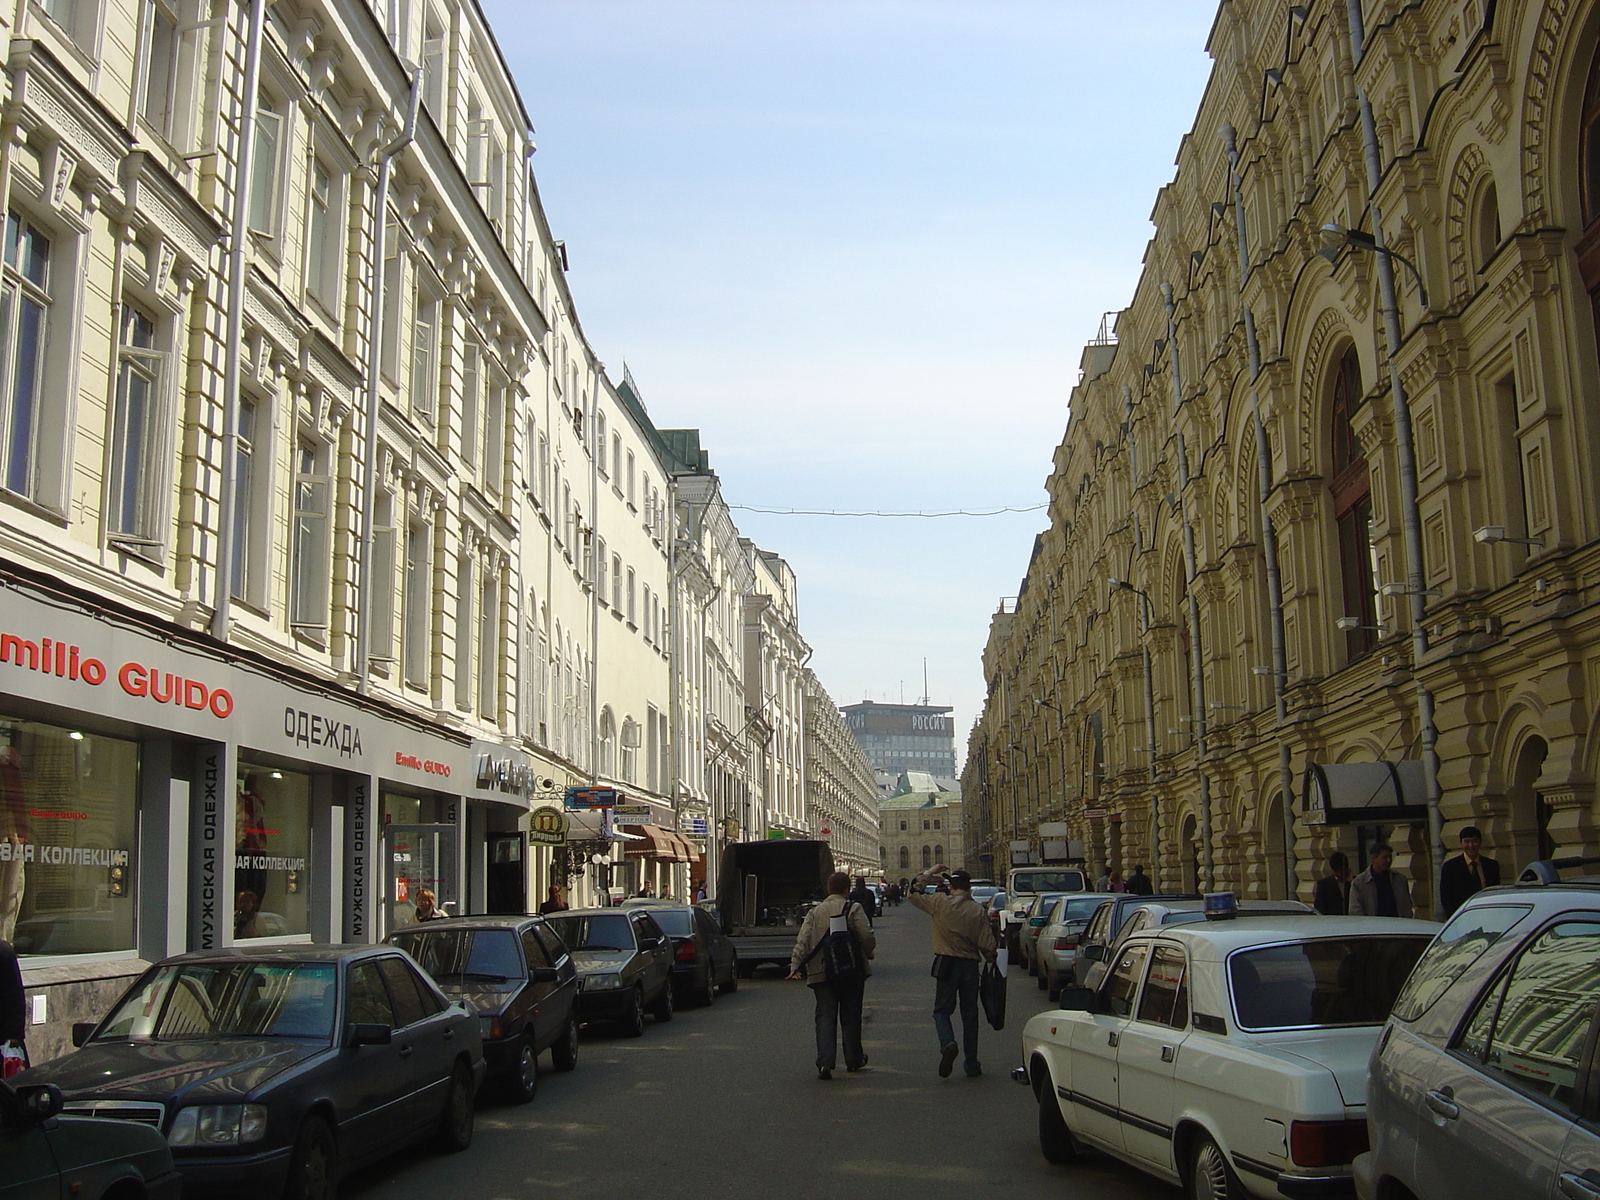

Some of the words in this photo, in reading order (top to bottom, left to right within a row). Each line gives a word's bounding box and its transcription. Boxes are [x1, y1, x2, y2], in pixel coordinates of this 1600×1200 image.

[118, 662, 234, 718] GUIDO
[285, 707, 362, 759] ОДЕЖДА
[847, 713, 865, 729] ССИЯ
[912, 714, 945, 730] РОССИЯ
[395, 752, 422, 771] Emilio
[423, 760, 451, 778] GUIDO
[60, 811, 87, 820] GUIDO
[204, 755, 217, 840] ОДЕЖДА
[354, 785, 365, 851] ОДЕЖДА
[0, 842, 34, 862] ВАЯ
[41, 845, 129, 867] КОЛЛЕКЦИЯ
[235, 855, 250, 870] АЯ
[252, 856, 304, 872] КОЛЛЕКЦИЯ
[202, 848, 215, 949] МУЖСКАЯ
[353, 857, 363, 936] МУЖСКАЯ
